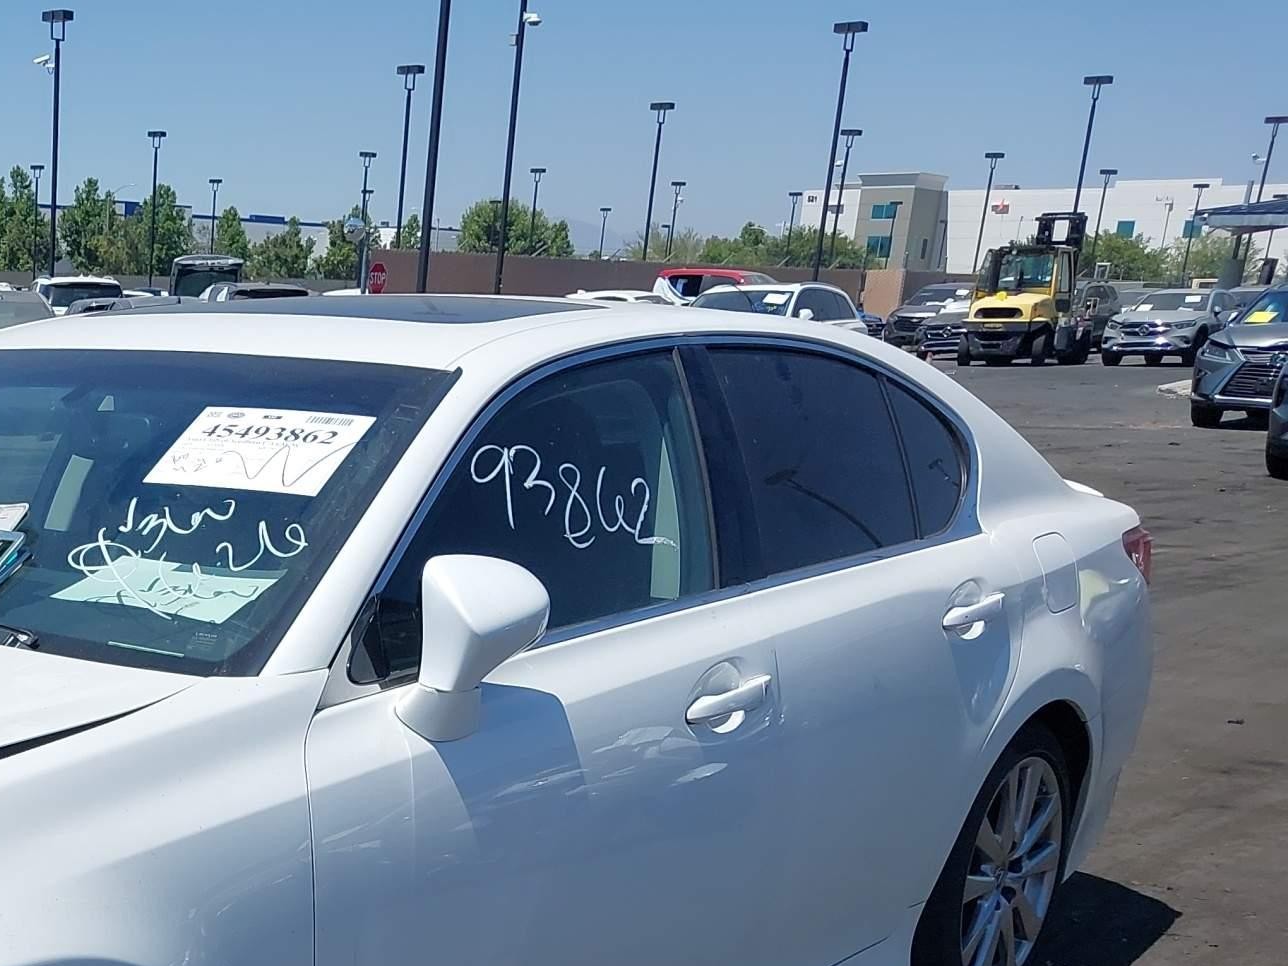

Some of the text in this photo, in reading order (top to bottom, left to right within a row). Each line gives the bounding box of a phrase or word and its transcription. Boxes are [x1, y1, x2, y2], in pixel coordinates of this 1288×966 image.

[369, 271, 386, 285] STOP
[202, 423, 339, 445] 45493862
[470, 444, 679, 552] 93862
